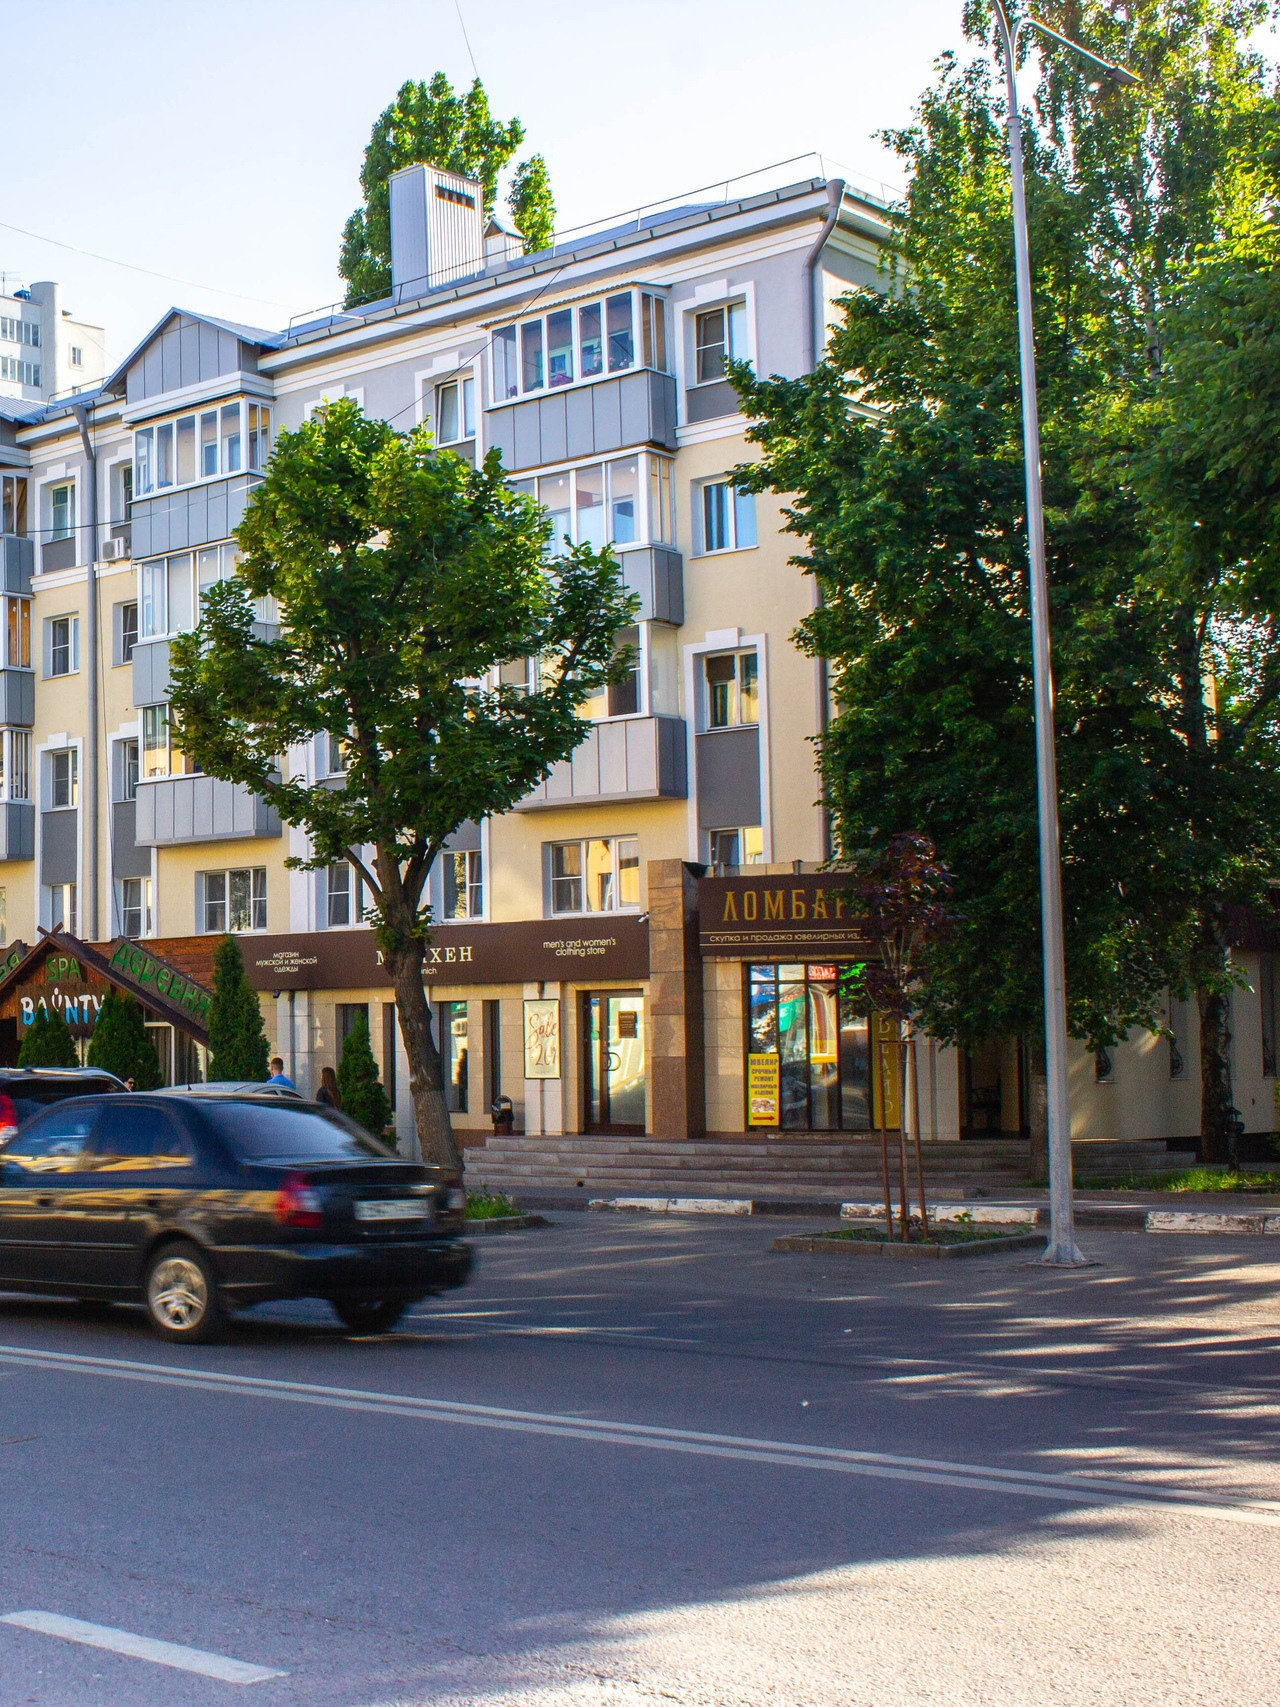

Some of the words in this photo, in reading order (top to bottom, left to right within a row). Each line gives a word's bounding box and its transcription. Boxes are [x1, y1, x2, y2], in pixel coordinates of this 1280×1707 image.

[722, 889, 870, 921] ЛОМБА
[543, 940, 565, 948] men's
[565, 939, 581, 947] and
[582, 937, 616, 946] women's
[709, 935, 741, 944] скупка
[751, 933, 793, 942] продажа
[794, 932, 846, 941] ювелирных
[272, 951, 299, 959] магазин
[376, 946, 473, 965] МХЕН
[555, 946, 586, 957] clothing
[587, 946, 605, 954] store
[256, 959, 283, 967] мужской
[289, 956, 317, 965] женской
[47, 957, 81, 980] SPA
